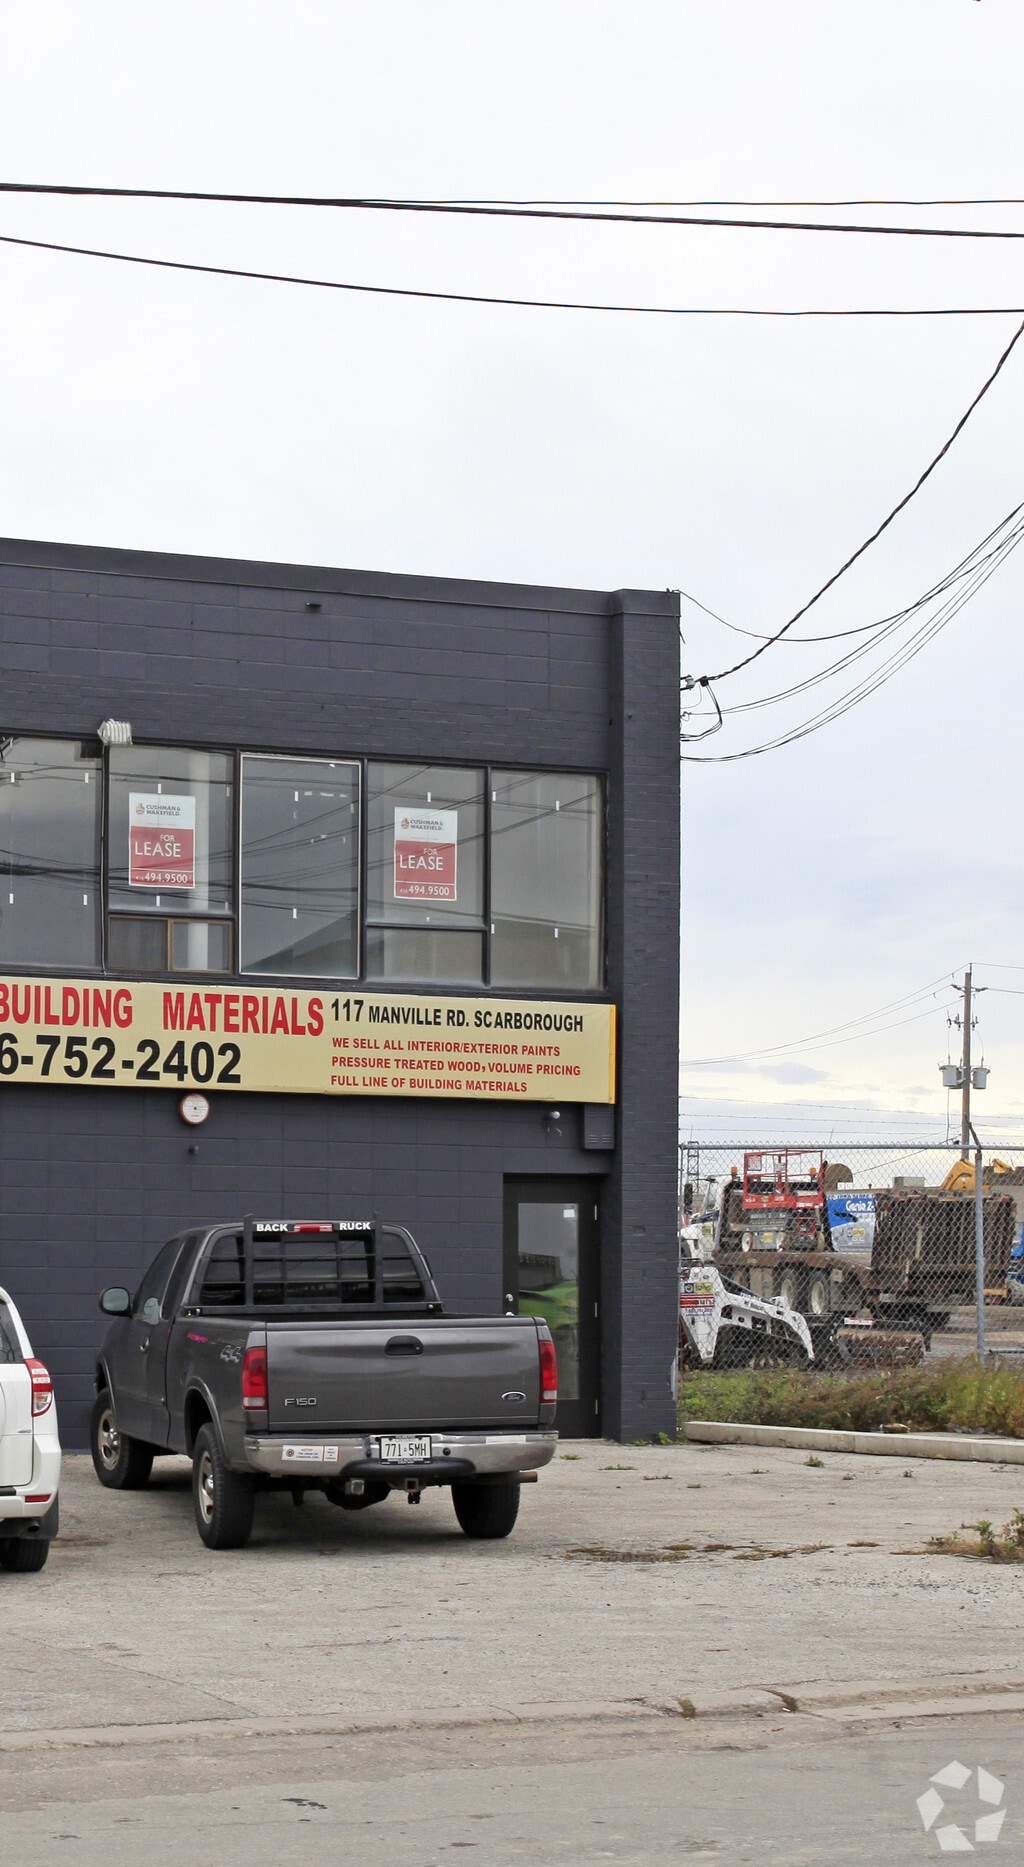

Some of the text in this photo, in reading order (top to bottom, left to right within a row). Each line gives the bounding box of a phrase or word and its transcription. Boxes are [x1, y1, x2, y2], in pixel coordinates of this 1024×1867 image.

[160, 834, 175, 842] FOR
[135, 841, 181, 857] LEASE
[399, 854, 444, 871] LEASE
[144, 872, 188, 883] 494.9500
[408, 885, 450, 896] 494.9500
[162, 991, 324, 1037] MATERIALS
[331, 998, 584, 1033] 117 MANVILLE RD. SCARBOROUGH
[331, 1037, 561, 1057] WE SELL ALL INTERIOR/EXTERIOR PAINTS
[331, 1055, 581, 1076] PRESSURE TREATED WOOD, VOLUME PRICING
[330, 1074, 528, 1093] FULL LINE OF BUILDING MATERIALS
[256, 1221, 372, 1232] BACK RUCK
[284, 1397, 317, 1406] F150
[384, 1442, 427, 1457] 771 5MH
